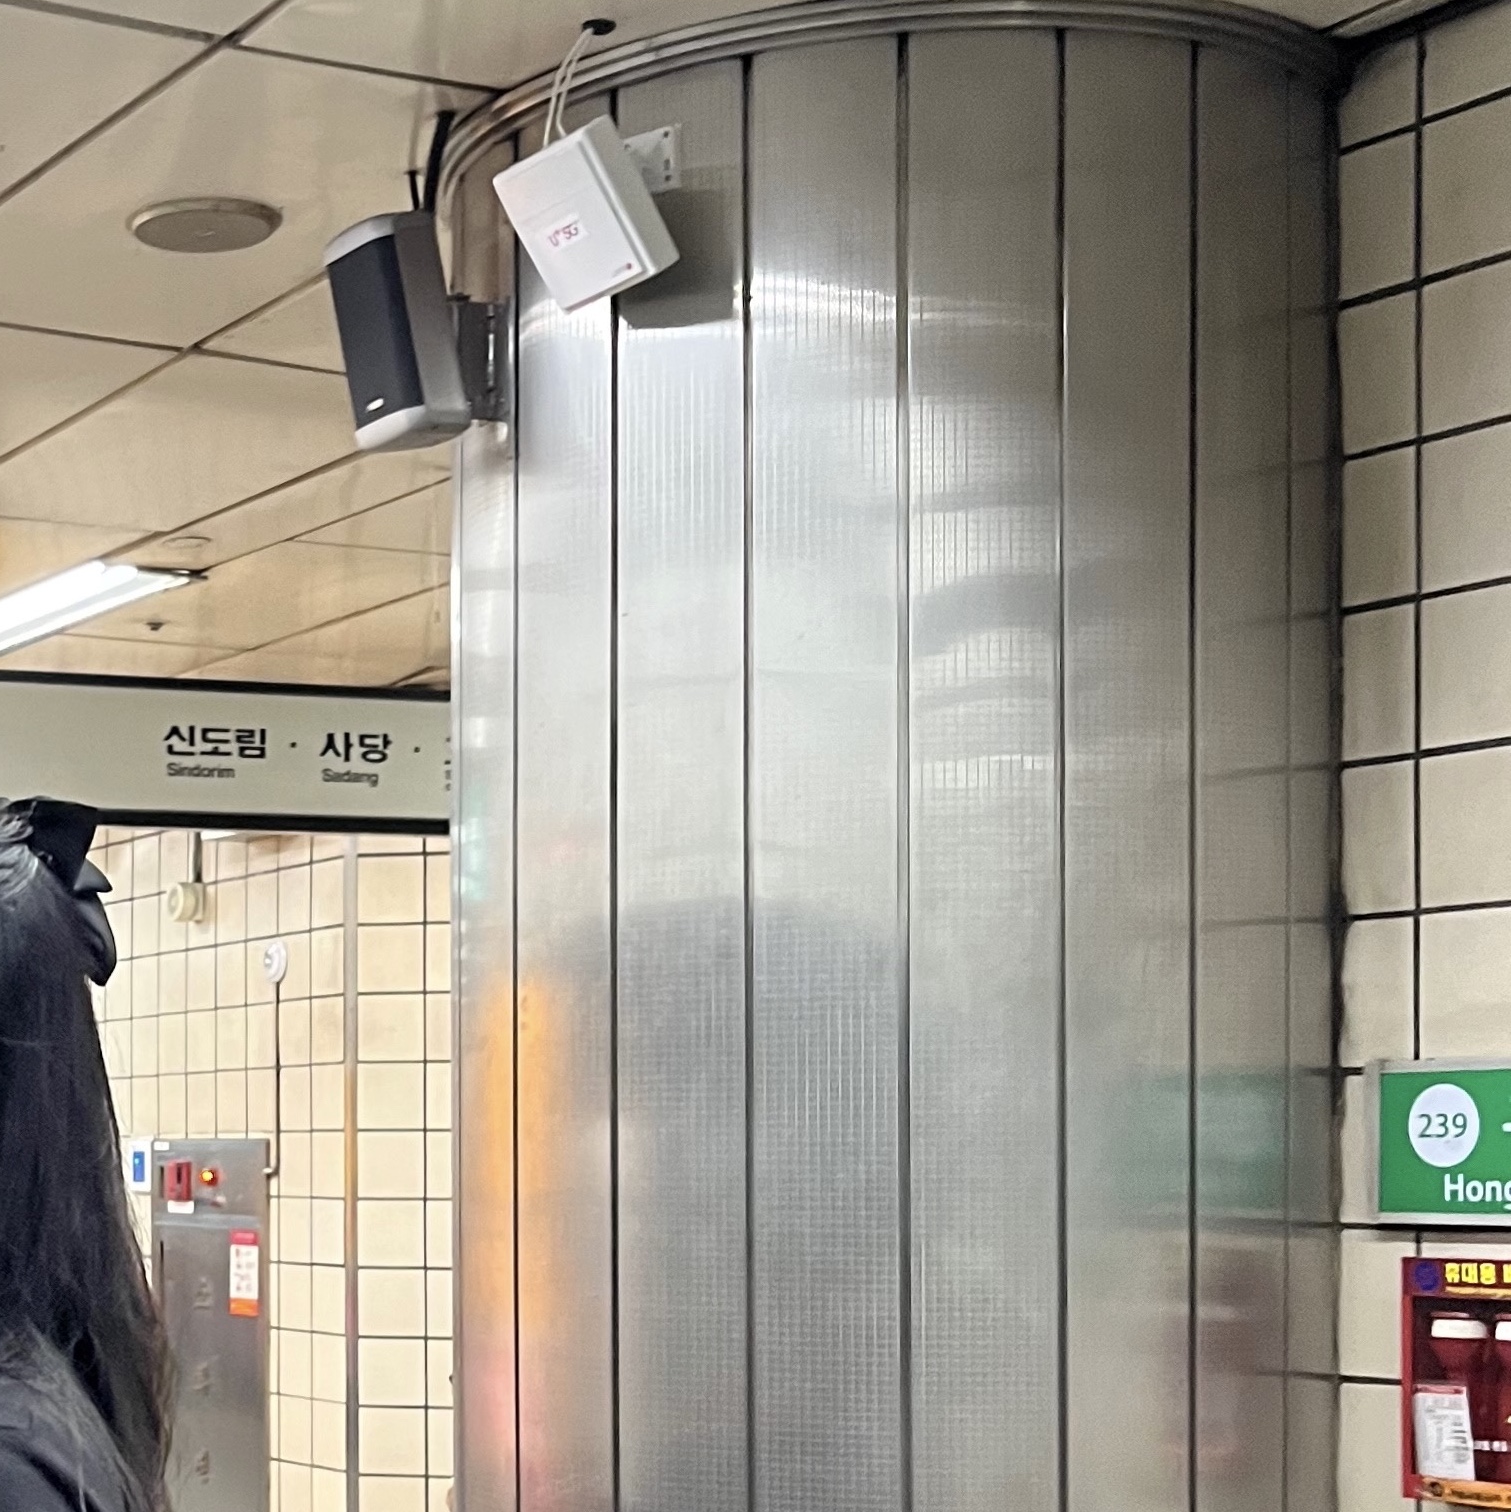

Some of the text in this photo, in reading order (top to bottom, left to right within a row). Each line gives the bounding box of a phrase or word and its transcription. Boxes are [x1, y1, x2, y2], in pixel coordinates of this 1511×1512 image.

[163, 725, 393, 763] 신도림 사당
[166, 762, 235, 778] Sindorim
[1417, 1113, 1468, 1138] 239
